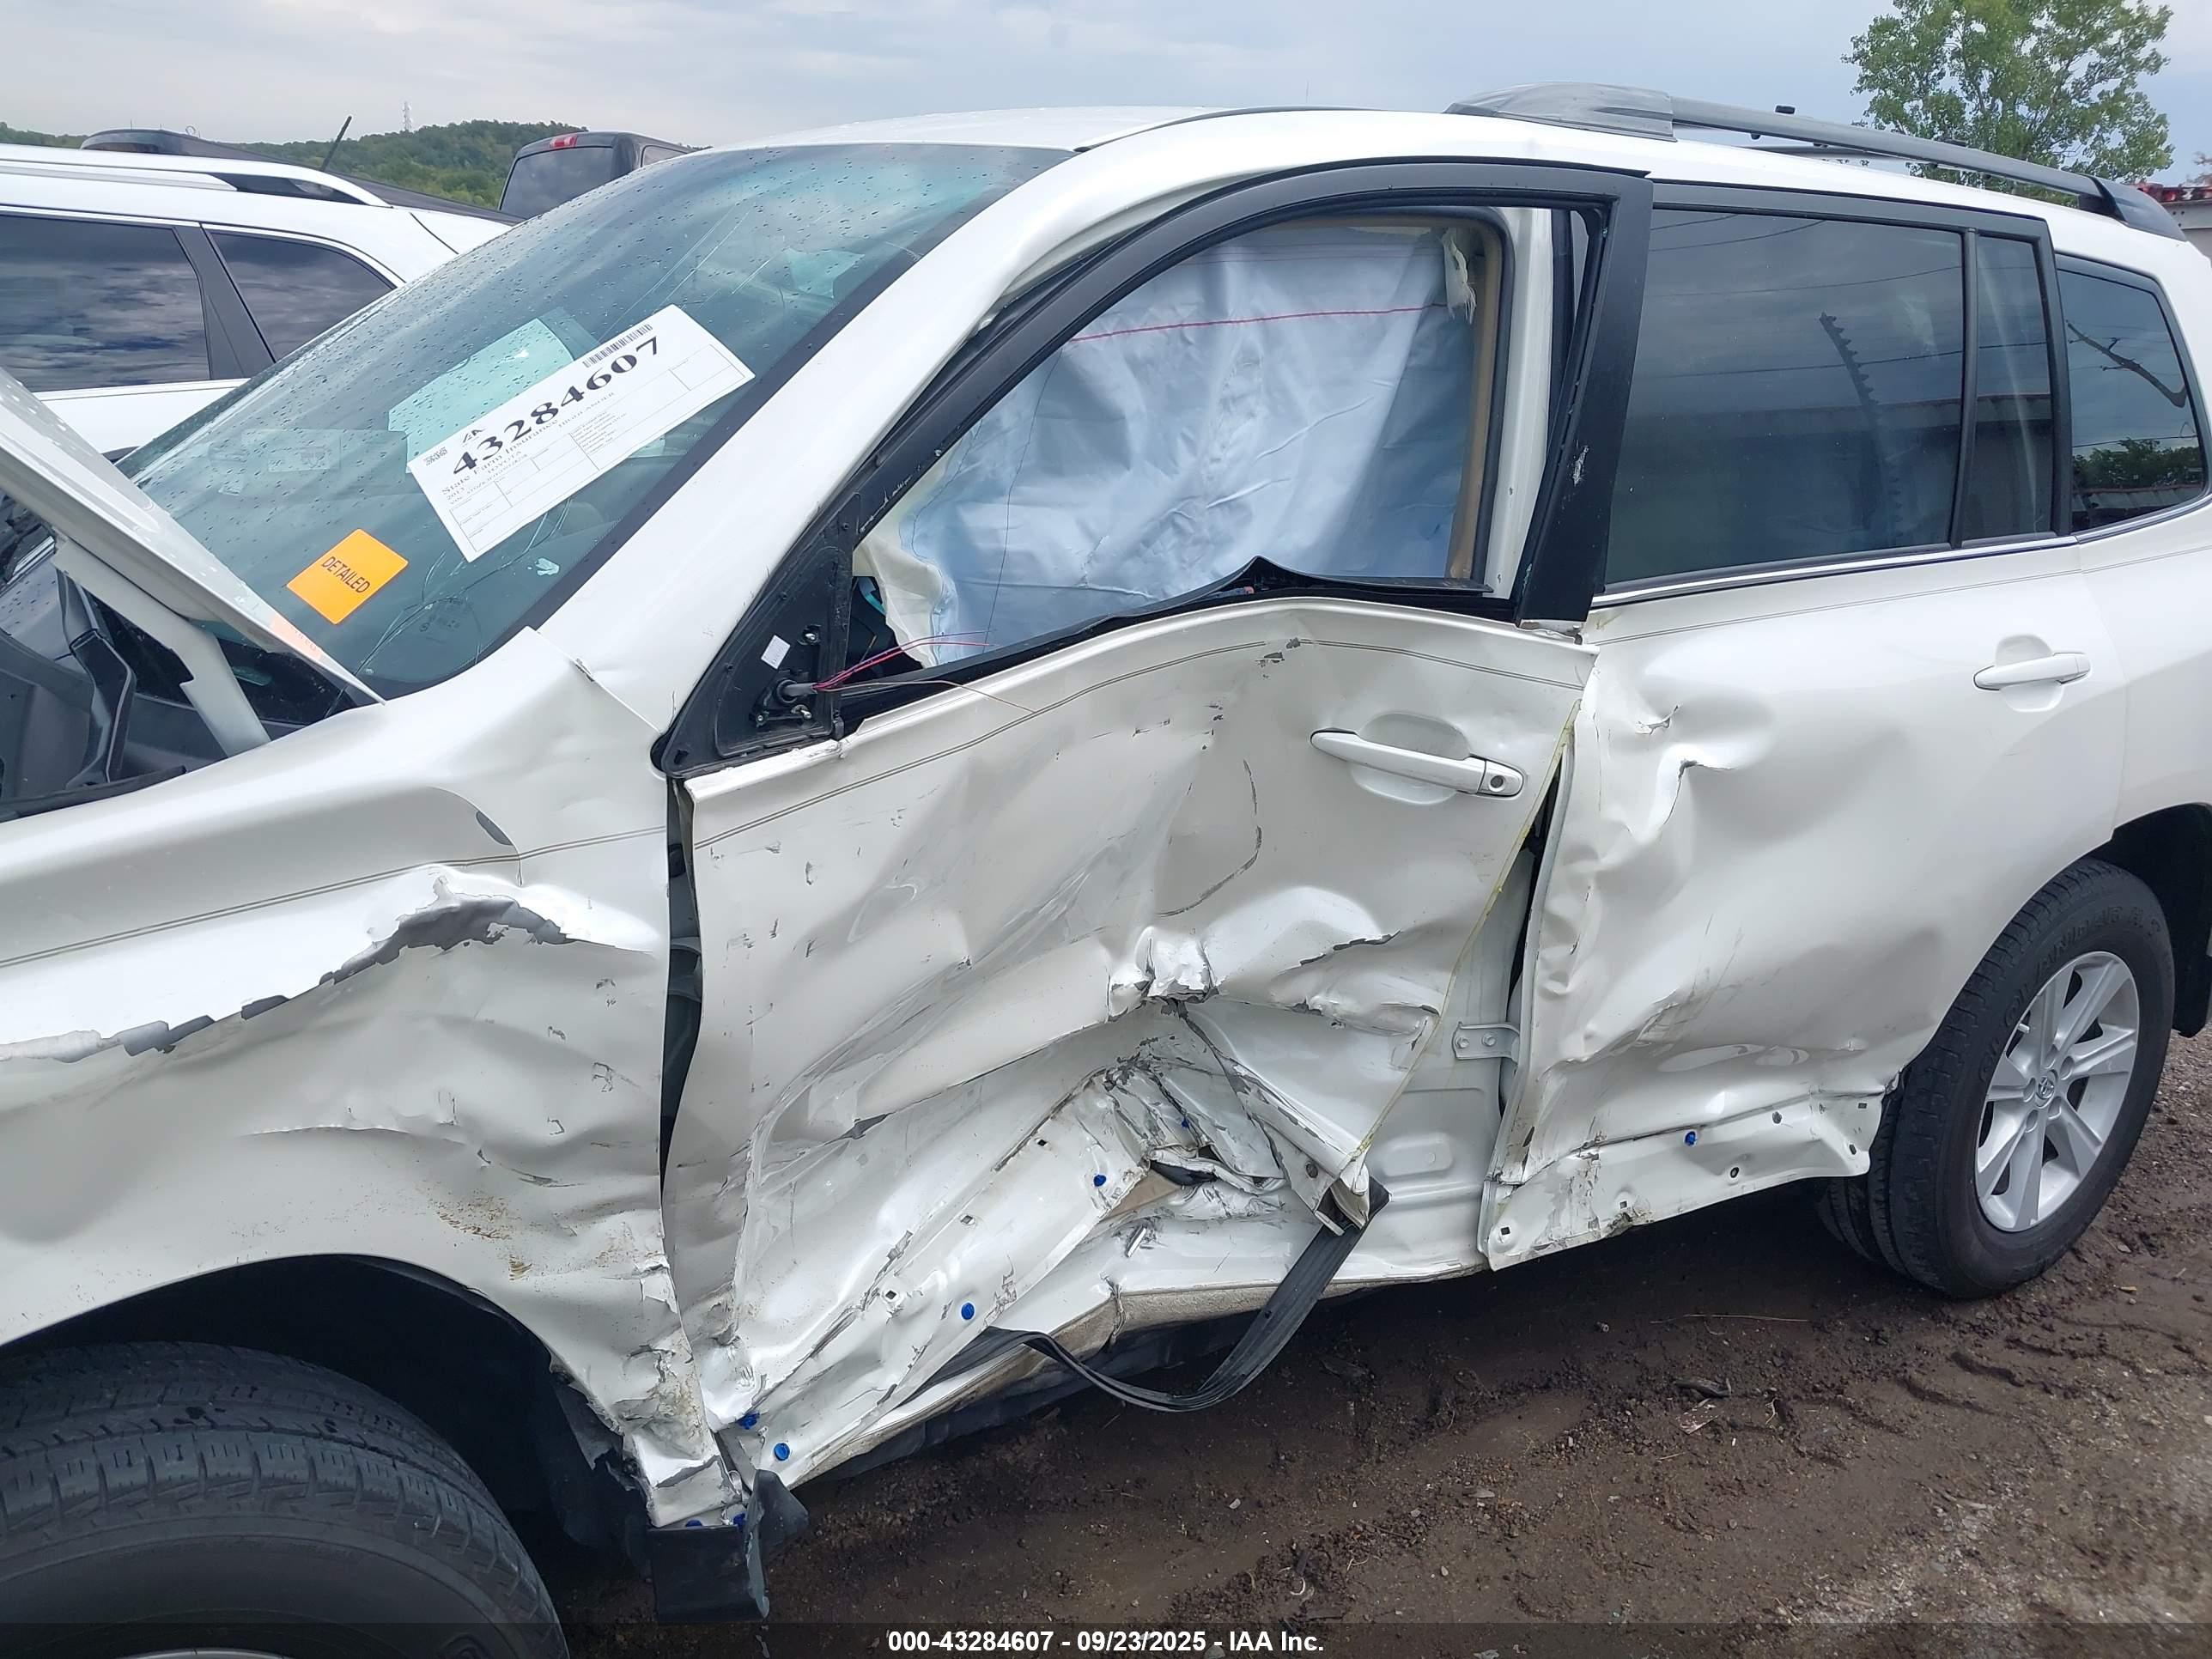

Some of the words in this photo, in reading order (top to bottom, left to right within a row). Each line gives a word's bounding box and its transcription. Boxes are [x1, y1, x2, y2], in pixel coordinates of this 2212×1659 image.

[453, 336, 659, 475] 43284607
[441, 475, 471, 495] State
[473, 455, 502, 474] Farm
[505, 420, 558, 454] Insurance
[321, 556, 370, 593] DETAILED
